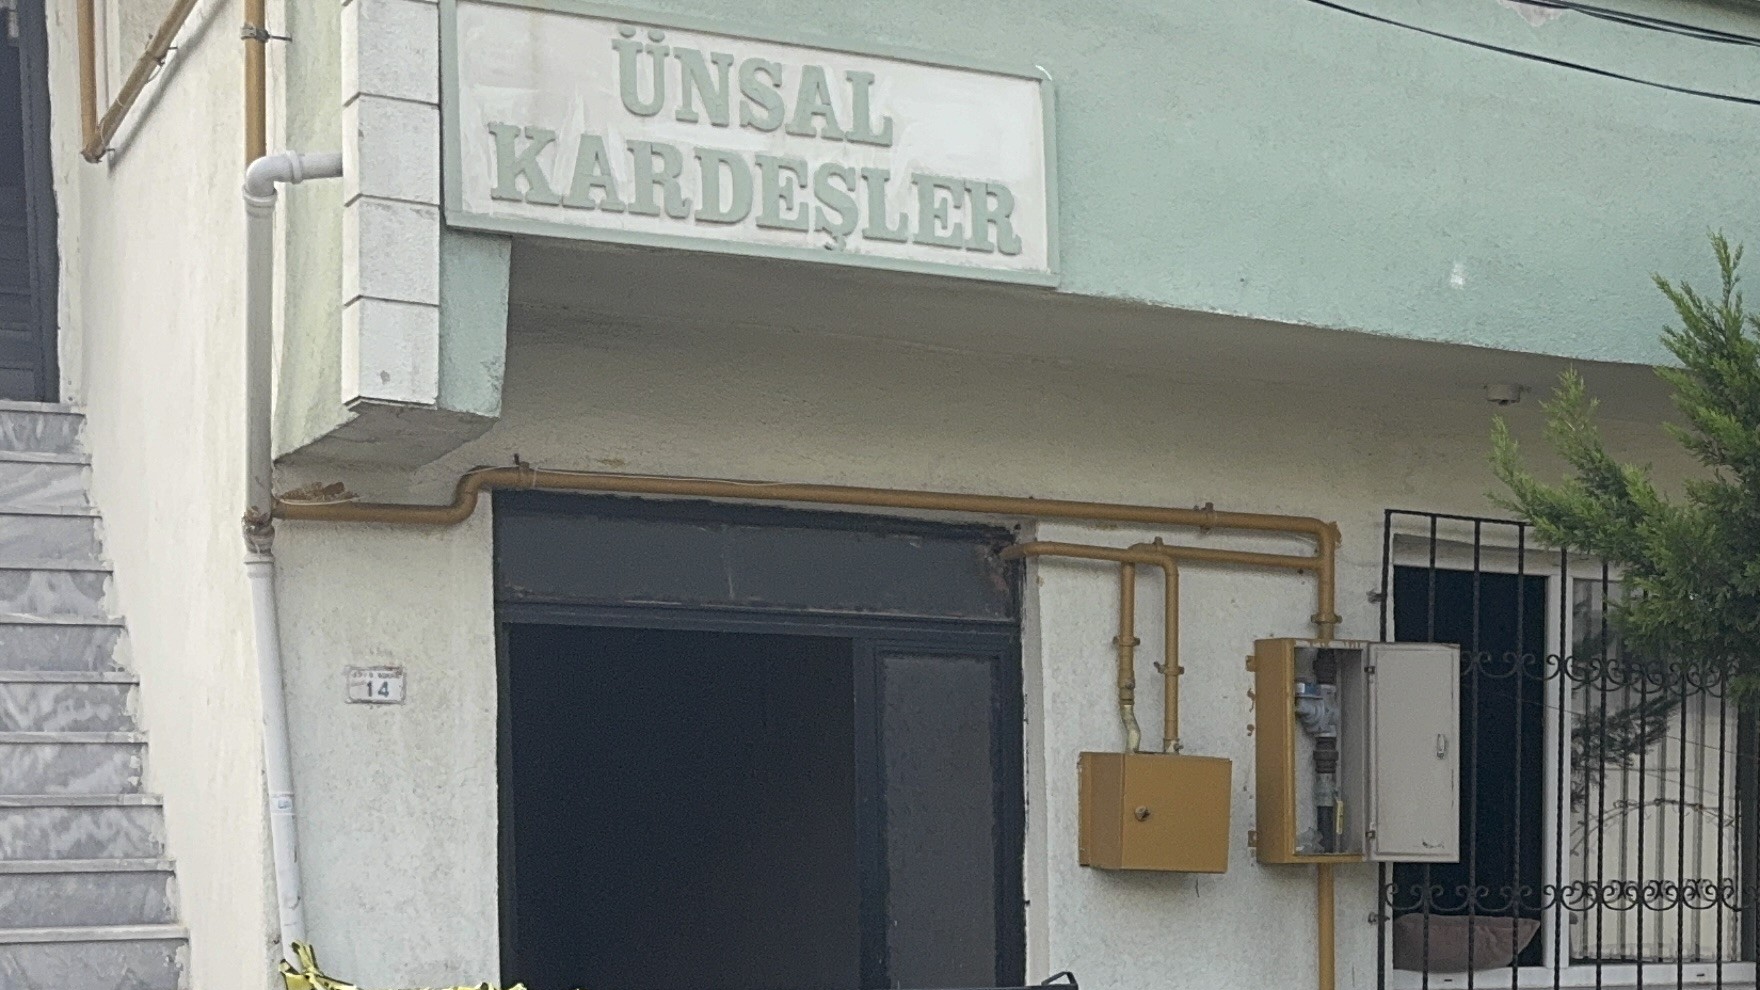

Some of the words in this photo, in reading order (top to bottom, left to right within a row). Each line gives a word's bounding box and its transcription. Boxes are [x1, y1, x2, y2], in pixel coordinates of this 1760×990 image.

[611, 26, 894, 147] ÜNSAL
[487, 121, 1023, 256] KARDEŞLER
[366, 681, 389, 698] 14
